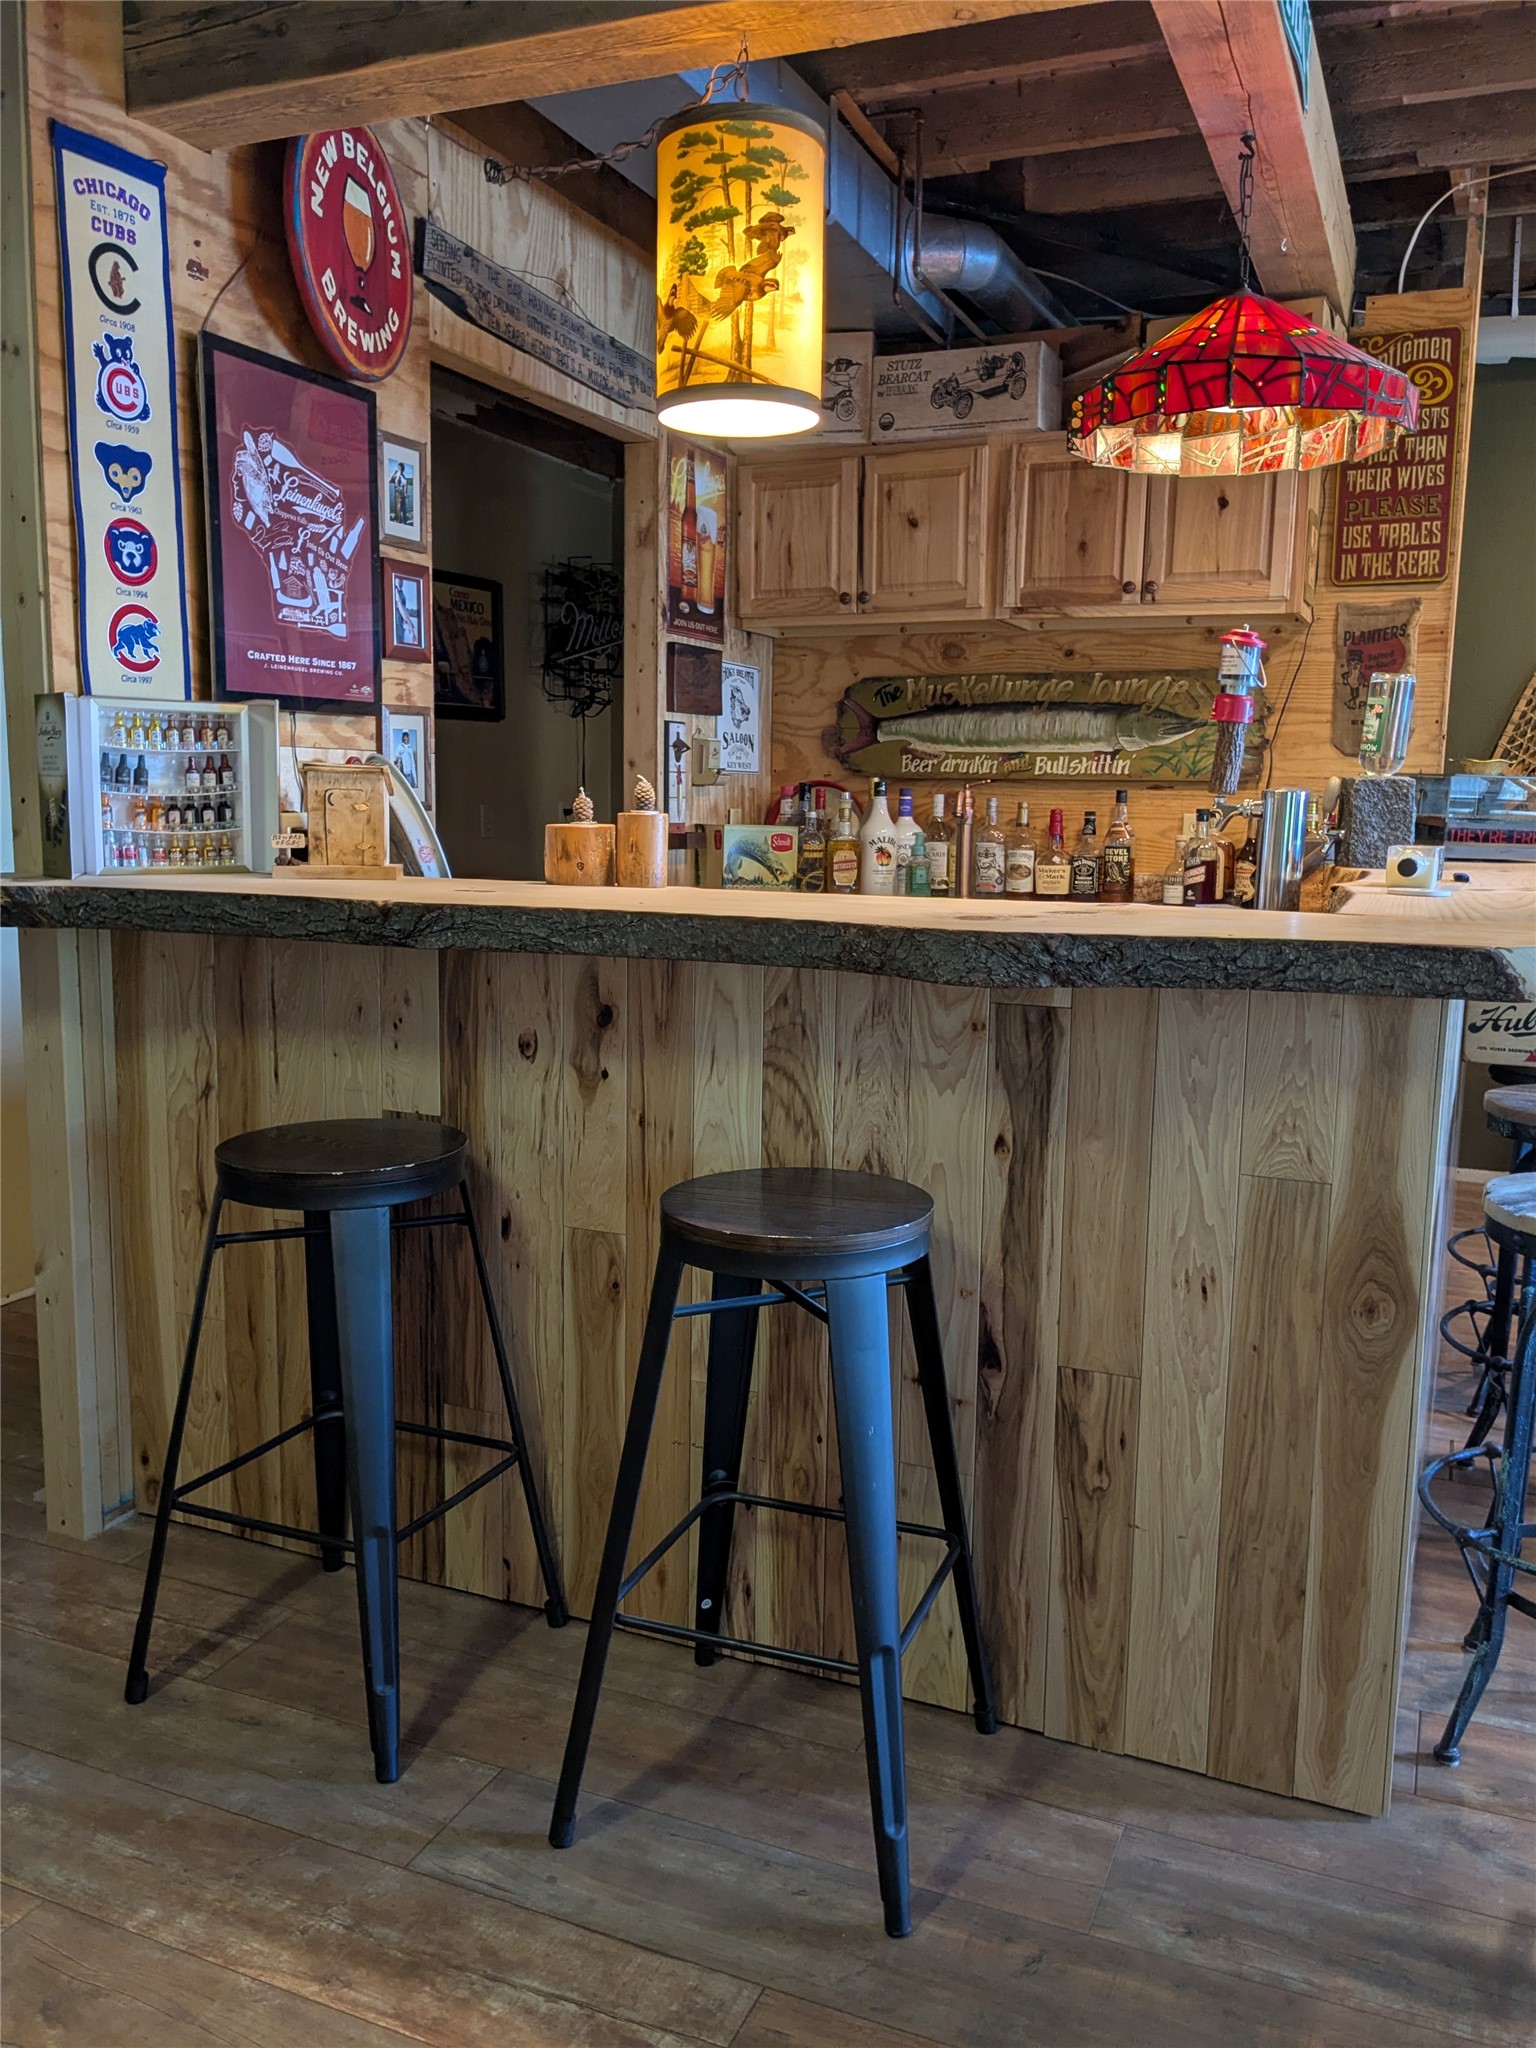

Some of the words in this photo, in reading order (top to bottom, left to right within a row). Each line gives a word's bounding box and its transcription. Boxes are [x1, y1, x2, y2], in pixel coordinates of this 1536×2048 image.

[73, 177, 151, 221] CHICAGO
[310, 134, 339, 218] NEW
[341, 131, 402, 280] BELGIUM
[113, 208, 136, 226] 1876
[91, 215, 137, 246] CUBS
[321, 267, 401, 354] BREWING
[100, 314, 118, 328] Circa
[119, 321, 136, 333] 1908
[886, 358, 923, 372] STUTZ
[877, 370, 932, 386] BEARCAT
[106, 419, 123, 431] Circa
[124, 424, 140, 435] 1959
[1404, 434, 1448, 464] THAN
[1346, 467, 1392, 495] THEIR
[1397, 464, 1446, 491] WIVES
[272, 470, 345, 524] Leinenkugel's
[1343, 493, 1442, 522] PLEASE
[110, 501, 127, 513] Circa
[127, 505, 143, 516] 1962
[1342, 524, 1373, 549] USE
[1378, 520, 1442, 549] TABLES
[306, 539, 318, 552] Join
[317, 546, 325, 557] Us
[325, 551, 336, 563] Out
[1340, 553, 1358, 581] IN
[1361, 551, 1393, 580] THE
[1395, 549, 1441, 578] REAR
[116, 587, 132, 598] Circa
[132, 590, 149, 600] 1994
[448, 586, 470, 600] Como
[450, 598, 485, 616] MEXICO
[673, 617, 688, 629] JOIN
[687, 619, 695, 630] US
[694, 621, 706, 632] OUT
[1343, 622, 1408, 648] PLANTERS
[247, 650, 287, 663] CRAFTED
[288, 655, 311, 666] HERE
[312, 657, 336, 669] SINCE
[338, 660, 357, 671] 1867
[270, 664, 309, 673] LEINENKUGEL
[309, 668, 334, 676] BREWING
[121, 674, 137, 684] Circa
[137, 676, 153, 686] 1997
[873, 683, 903, 708] The
[723, 731, 755, 753] SALOON
[727, 761, 738, 769] KEY
[738, 762, 753, 770] WEST
[902, 754, 937, 775] Beer
[1002, 754, 1033, 775] and
[1034, 753, 1137, 776] Bullshittin'
[1105, 848, 1129, 856] REVEL
